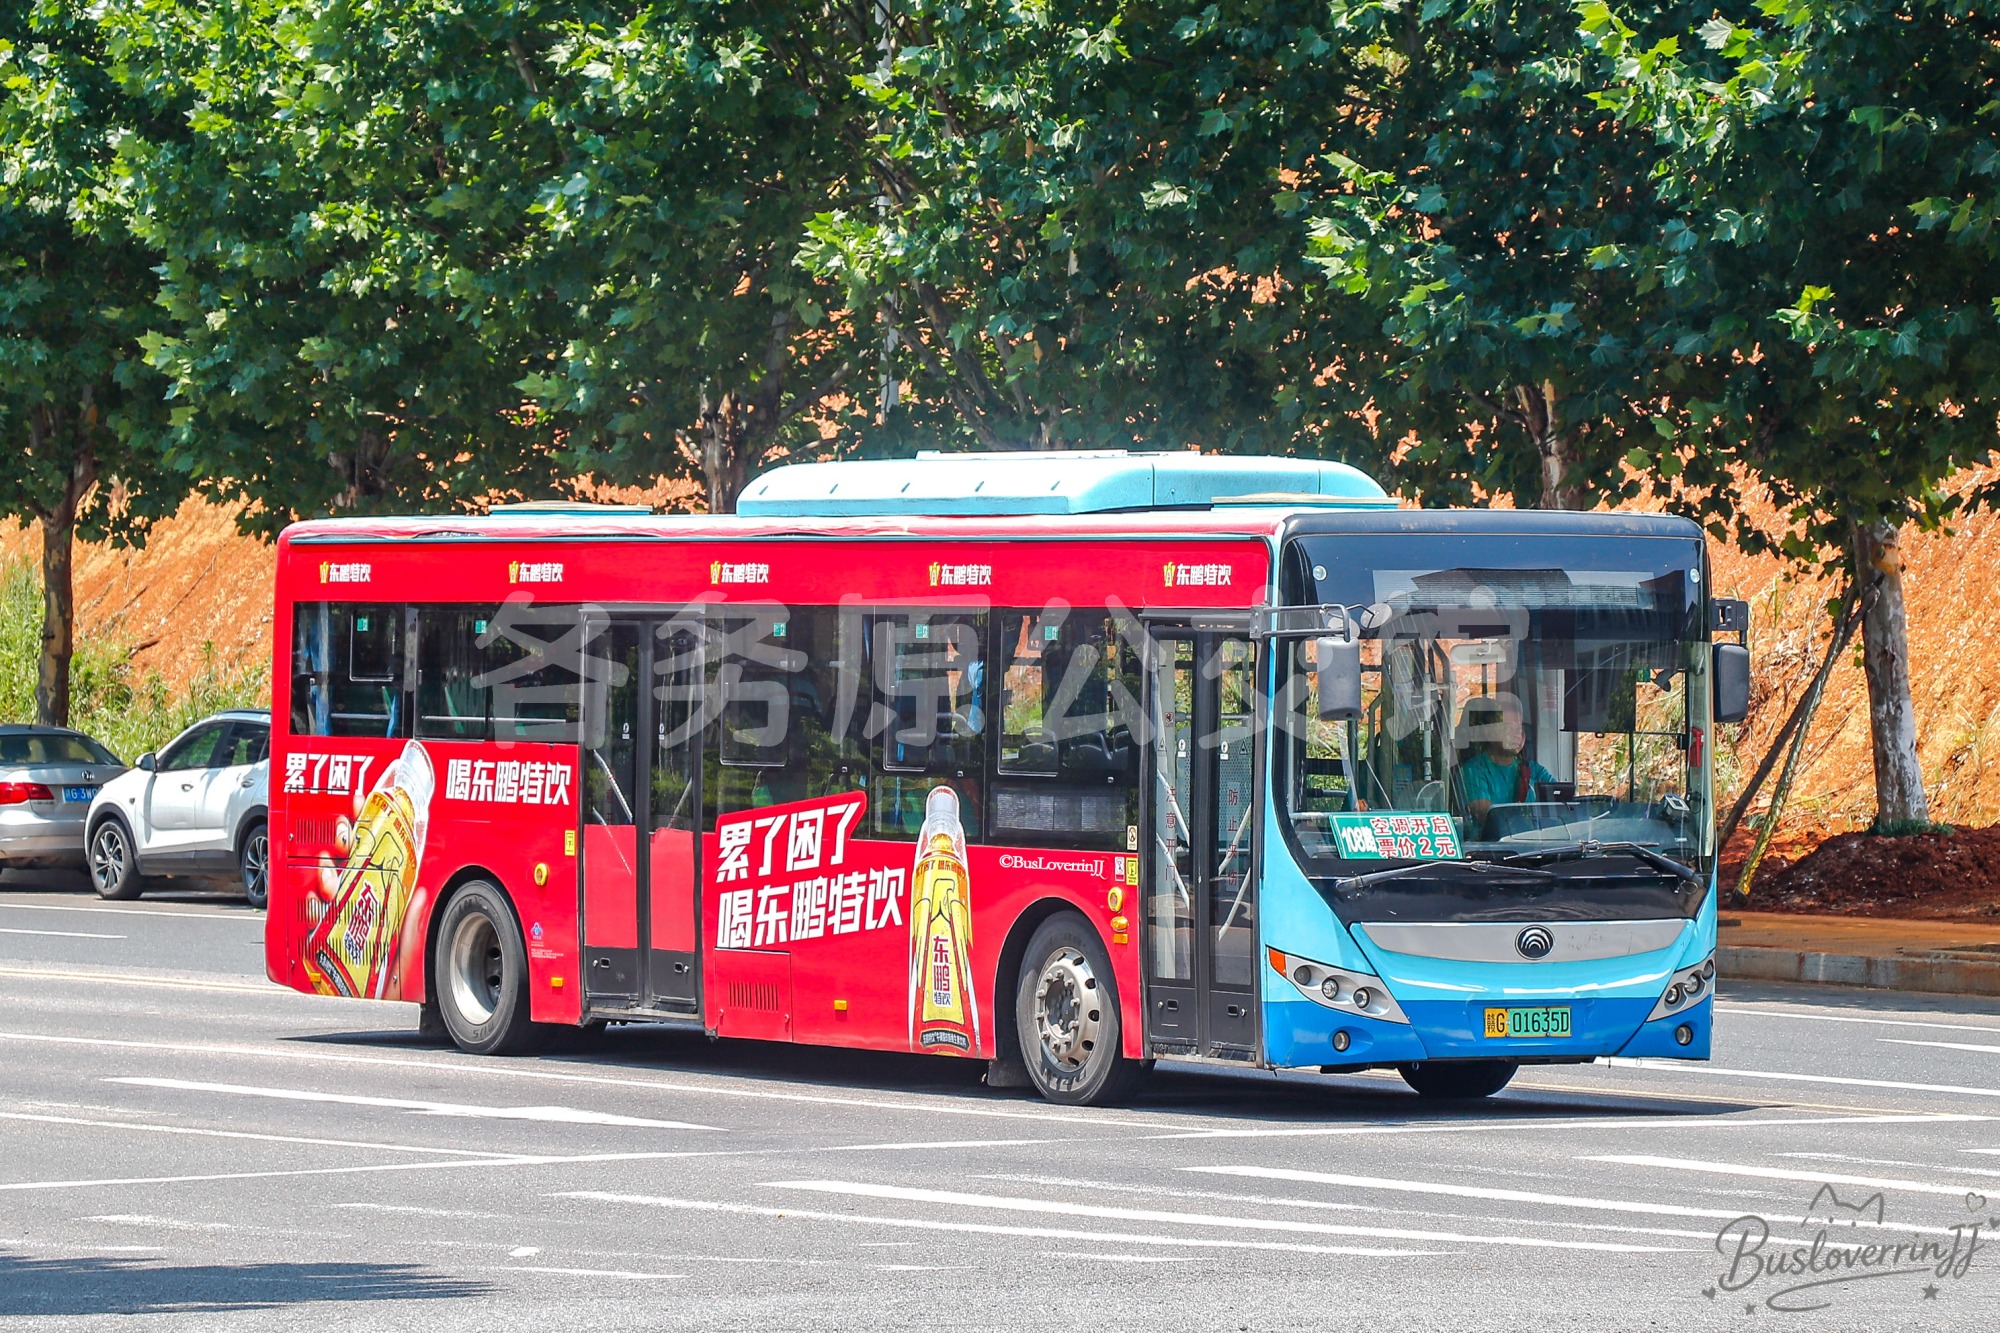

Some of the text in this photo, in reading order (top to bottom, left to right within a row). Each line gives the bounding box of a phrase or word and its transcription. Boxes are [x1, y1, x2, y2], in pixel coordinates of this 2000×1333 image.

[329, 563, 371, 582] 东鹏特饮
[519, 563, 564, 582] 东鹏特饮
[721, 562, 769, 583] 东鹏特饮
[940, 563, 992, 585] 东鹏特饮
[1176, 563, 1232, 586] 东鹏特饮
[283, 752, 375, 796] 累了困了
[445, 758, 572, 806] 喝东鹏特饮
[1371, 816, 1450, 835] 空调开启
[716, 801, 861, 883] 累了困了
[1378, 837, 1456, 858] 票价2元
[716, 865, 906, 949] 喝东鹏特饮
